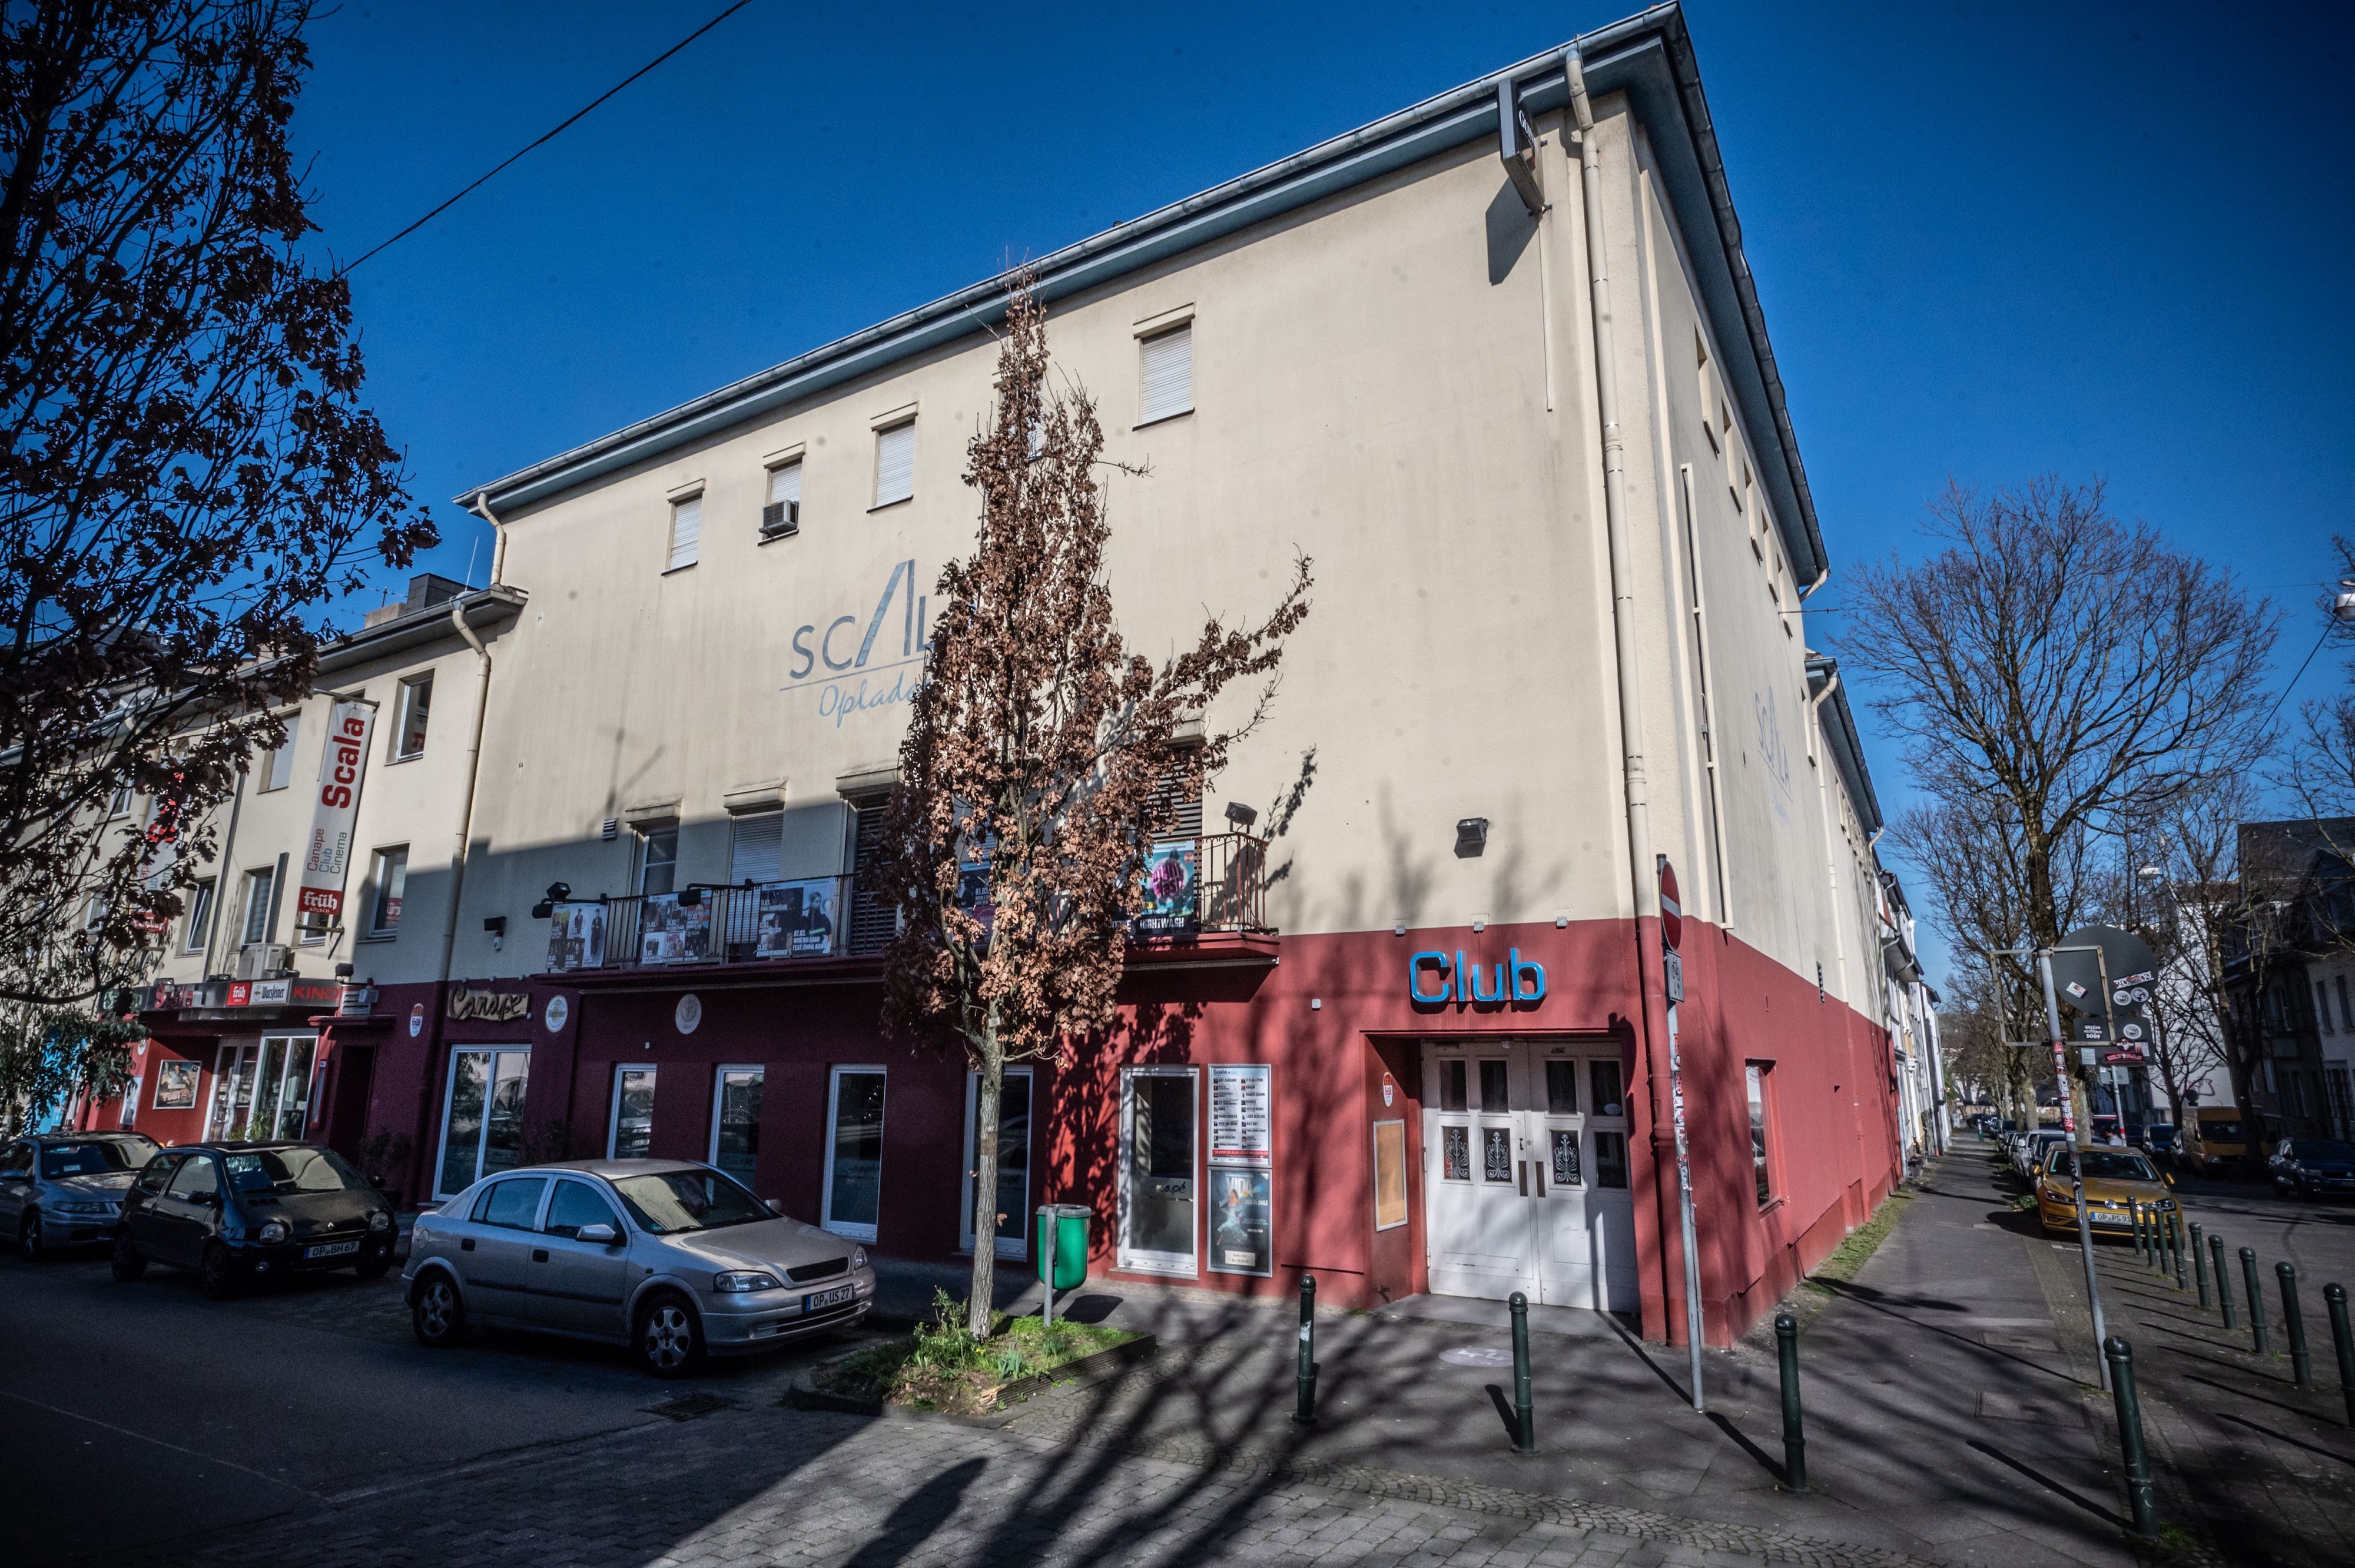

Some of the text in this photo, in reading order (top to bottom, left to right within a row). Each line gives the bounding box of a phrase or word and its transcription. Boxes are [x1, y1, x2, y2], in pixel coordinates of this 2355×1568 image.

[789, 559, 936, 679] SCAL
[819, 670, 930, 728] Oplade
[321, 717, 365, 809] Scala
[307, 829, 325, 871] Canape
[319, 848, 332, 872] Club
[330, 832, 347, 873] Cinema
[303, 891, 337, 910] früh
[1140, 918, 1185, 929] NIGHTWASH
[1410, 948, 1548, 1002] Club
[294, 986, 339, 999] KINO
[1226, 1177, 1253, 1199] VIDA
[313, 1247, 326, 1256] OP
[344, 1243, 356, 1252] 67
[814, 1288, 850, 1307] OP US 27
